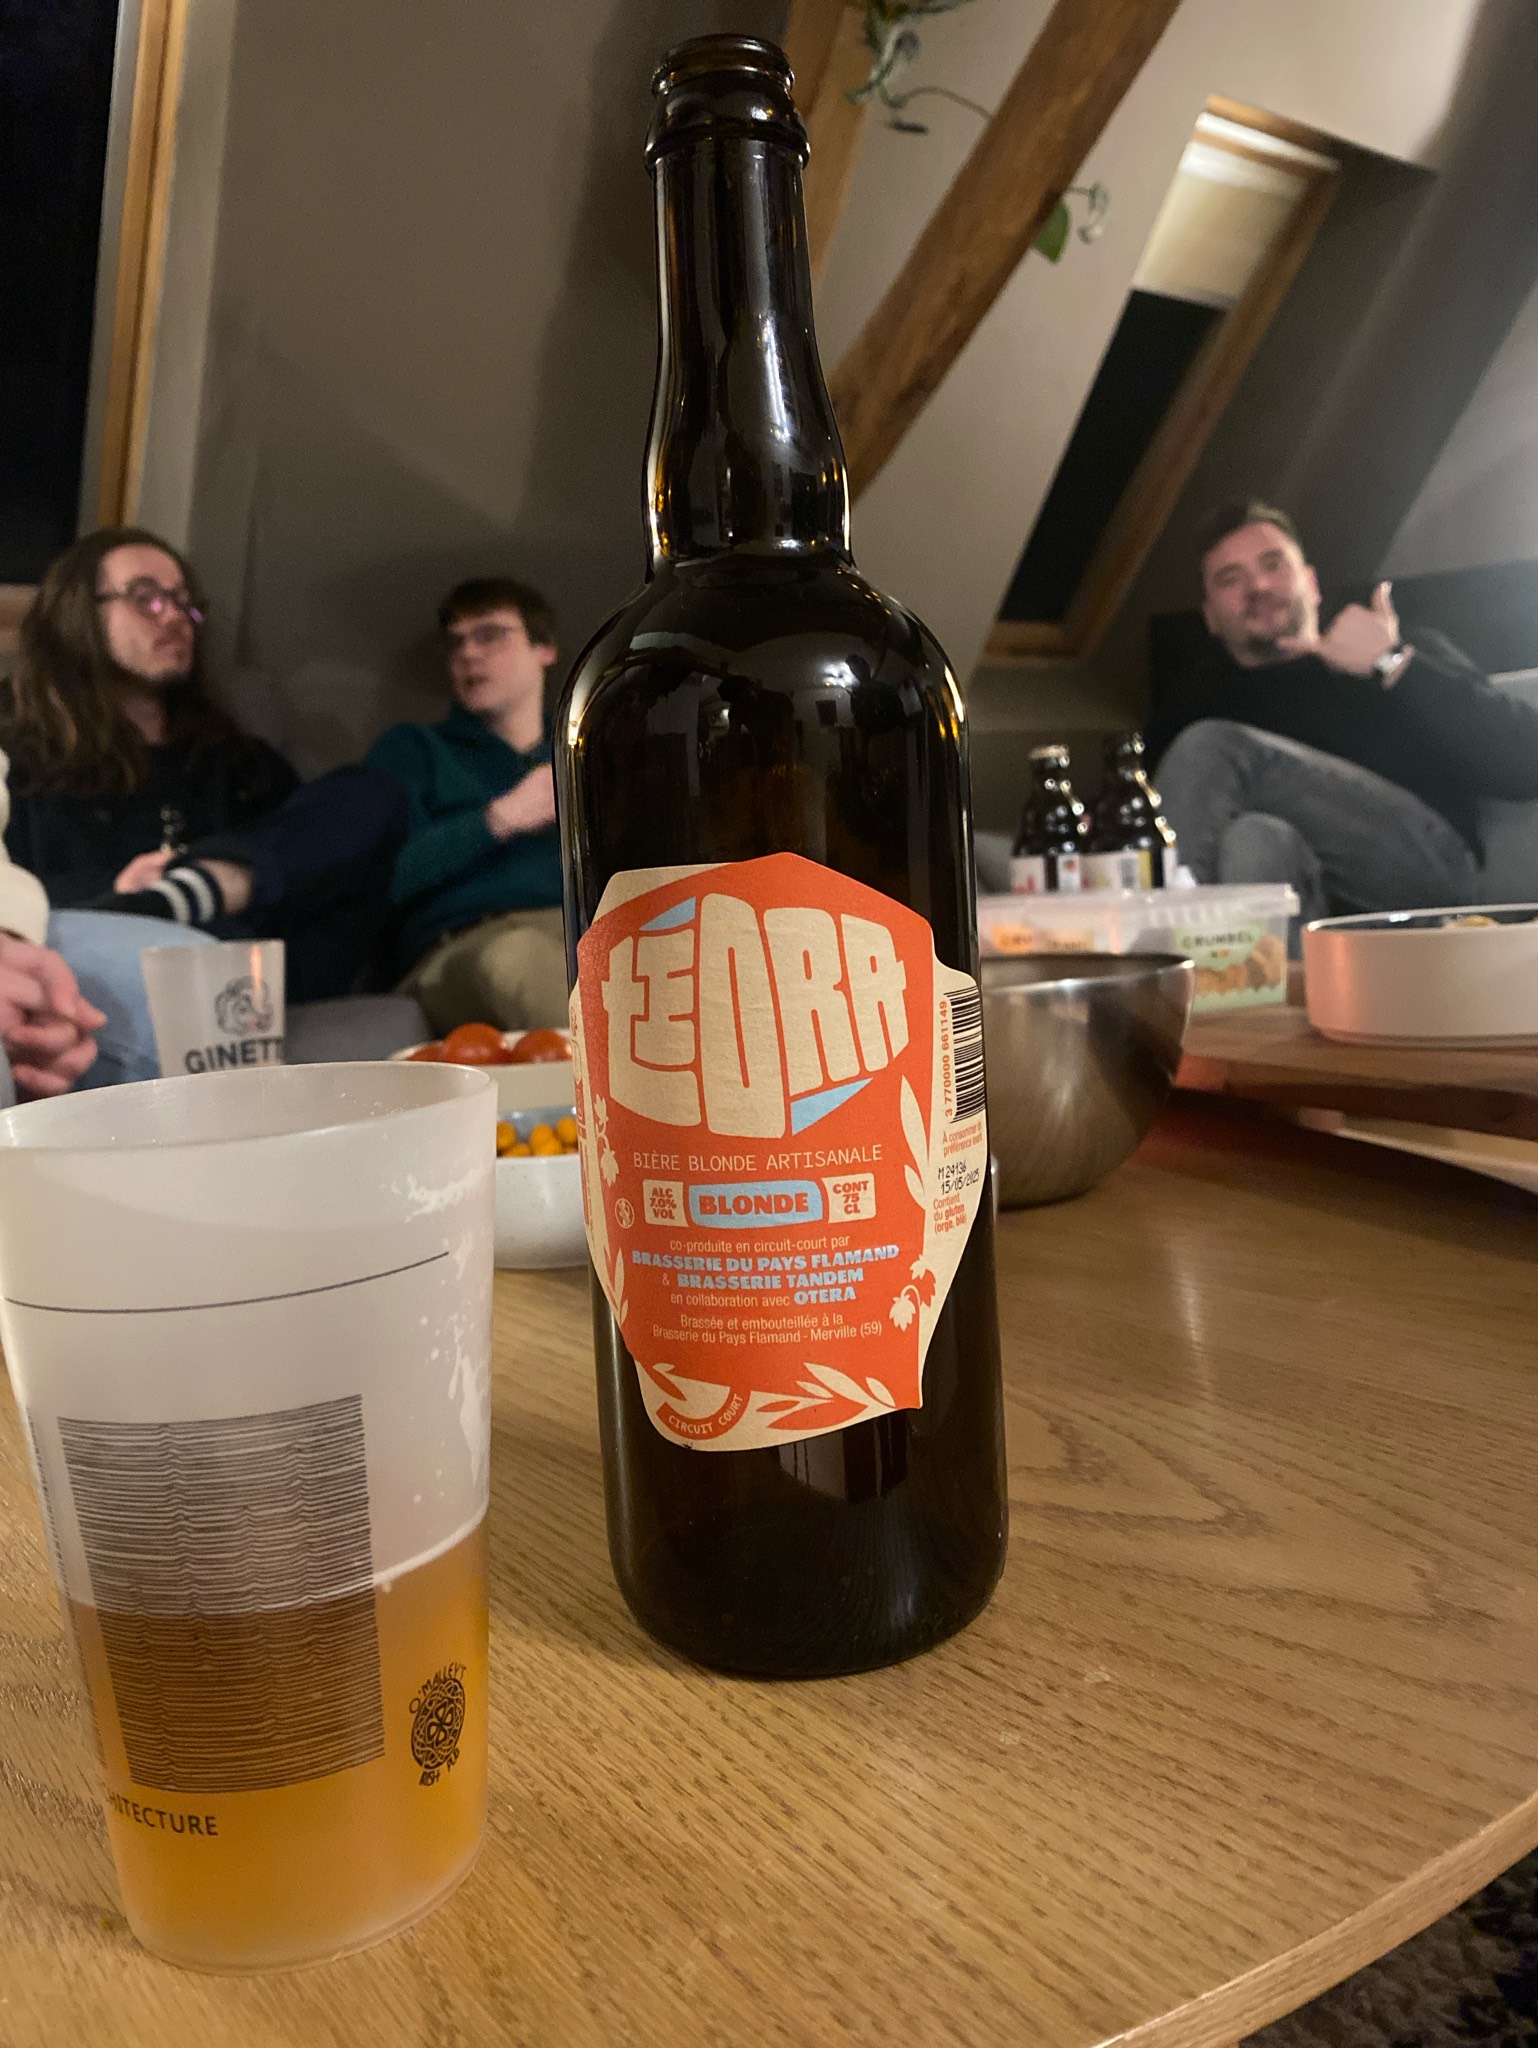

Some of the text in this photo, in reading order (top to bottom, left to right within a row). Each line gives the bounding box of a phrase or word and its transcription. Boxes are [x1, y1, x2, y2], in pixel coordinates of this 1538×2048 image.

[939, 1000, 952, 1051] 661149
[941, 1054, 954, 1105] 770000
[633, 1143, 884, 1172] BIÈRE BLONDE ARTISANALE
[652, 1188, 674, 1198] ALC
[832, 1180, 870, 1195] CONT
[842, 1193, 861, 1204] 75
[653, 1208, 676, 1220] VOL
[699, 1192, 810, 1216] BLONDE
[843, 1203, 862, 1215] CL
[670, 1235, 850, 1254] co-produite en circuit-court par
[632, 1244, 900, 1273] BRASSERIE DU PAYS FLAMAND
[662, 1268, 864, 1290] & BRASSERIE TANDEM
[670, 1286, 857, 1308] en collaboration avec OTERA
[680, 1312, 844, 1331] Brassée et embouteillée à la
[652, 1324, 699, 1341] Brasserie
[701, 1330, 716, 1343] du
[719, 1331, 746, 1346] Pays
[749, 1330, 801, 1344] Flamand
[810, 1326, 857, 1341] Merville
[860, 1320, 883, 1338] (59)
[668, 1393, 743, 1434] CIRCUIT COURT
